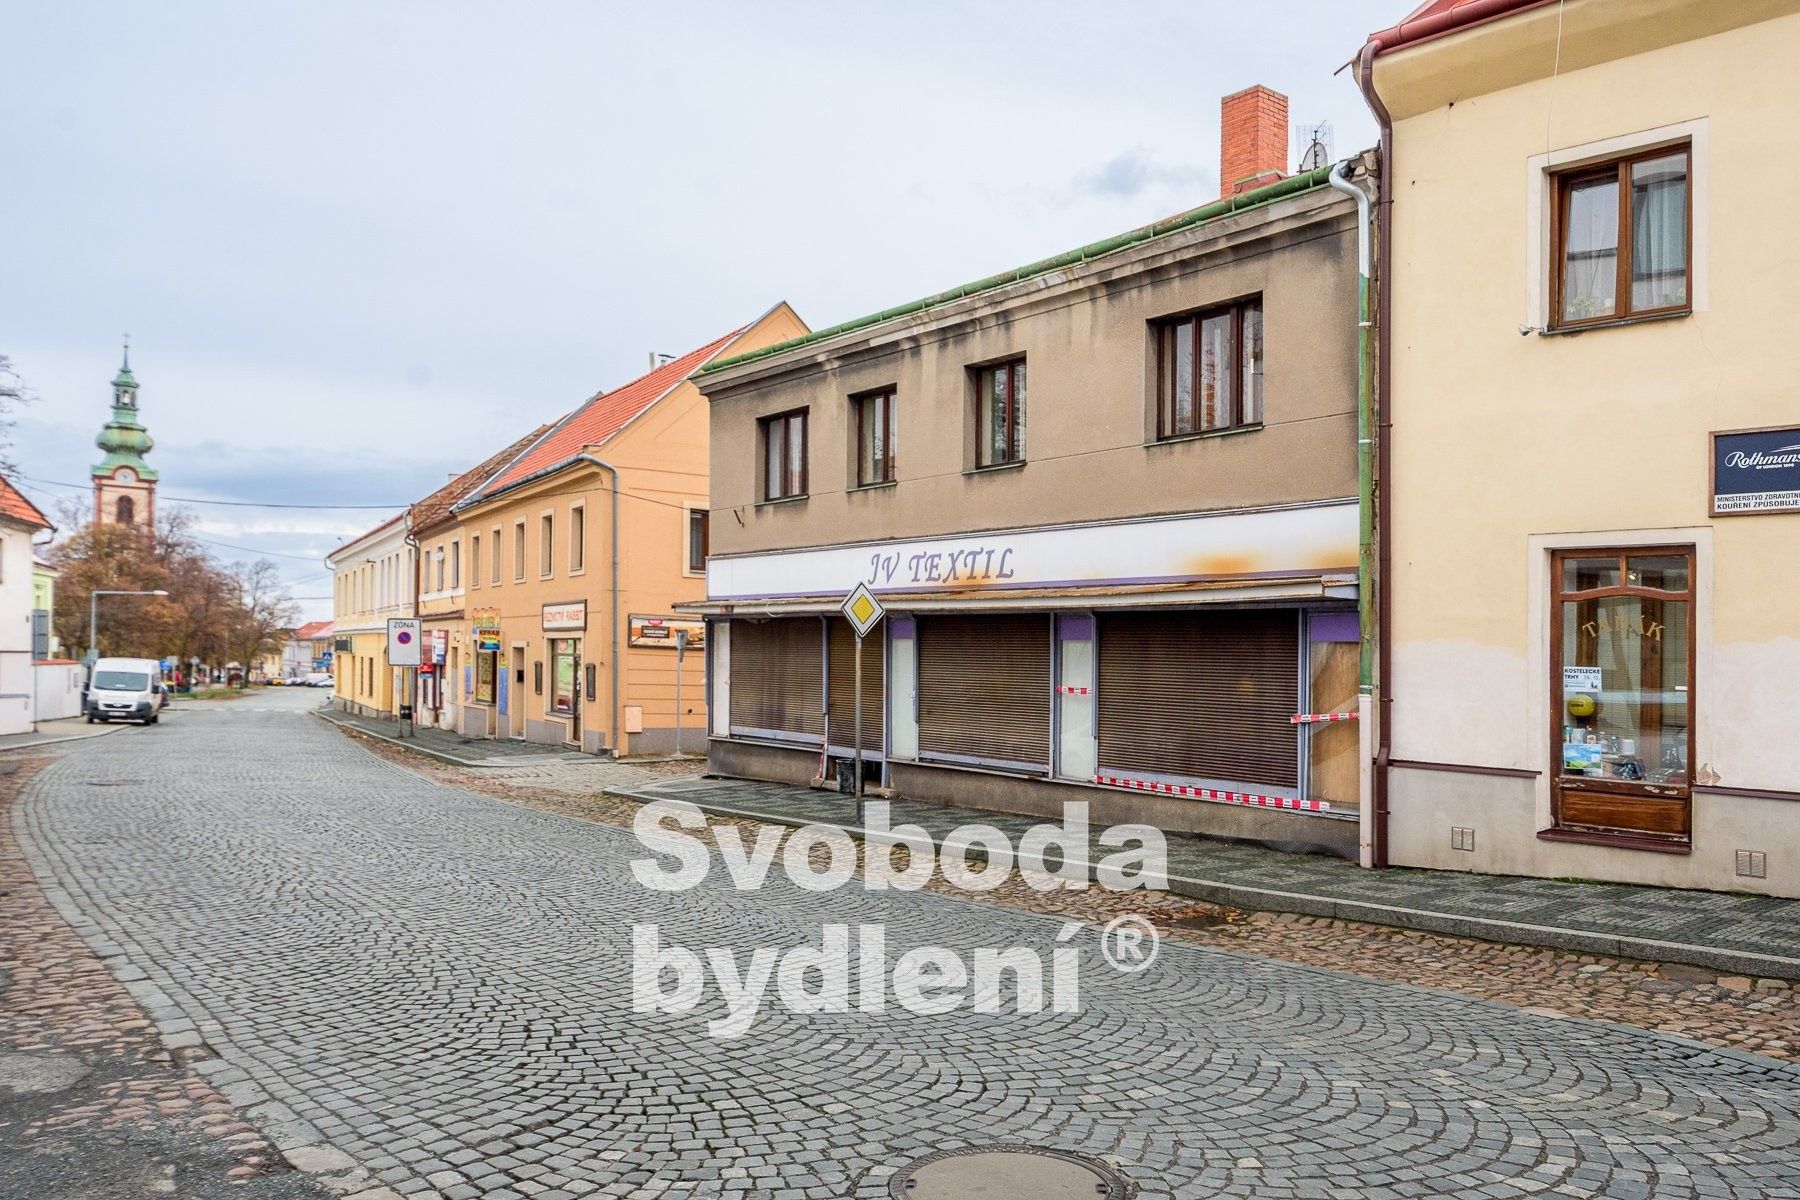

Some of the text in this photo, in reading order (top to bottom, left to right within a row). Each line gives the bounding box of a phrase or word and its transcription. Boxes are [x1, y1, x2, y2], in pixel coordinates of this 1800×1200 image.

[1725, 452, 1800, 468] Rothmans
[868, 547, 1014, 585] JV TEXTIL
